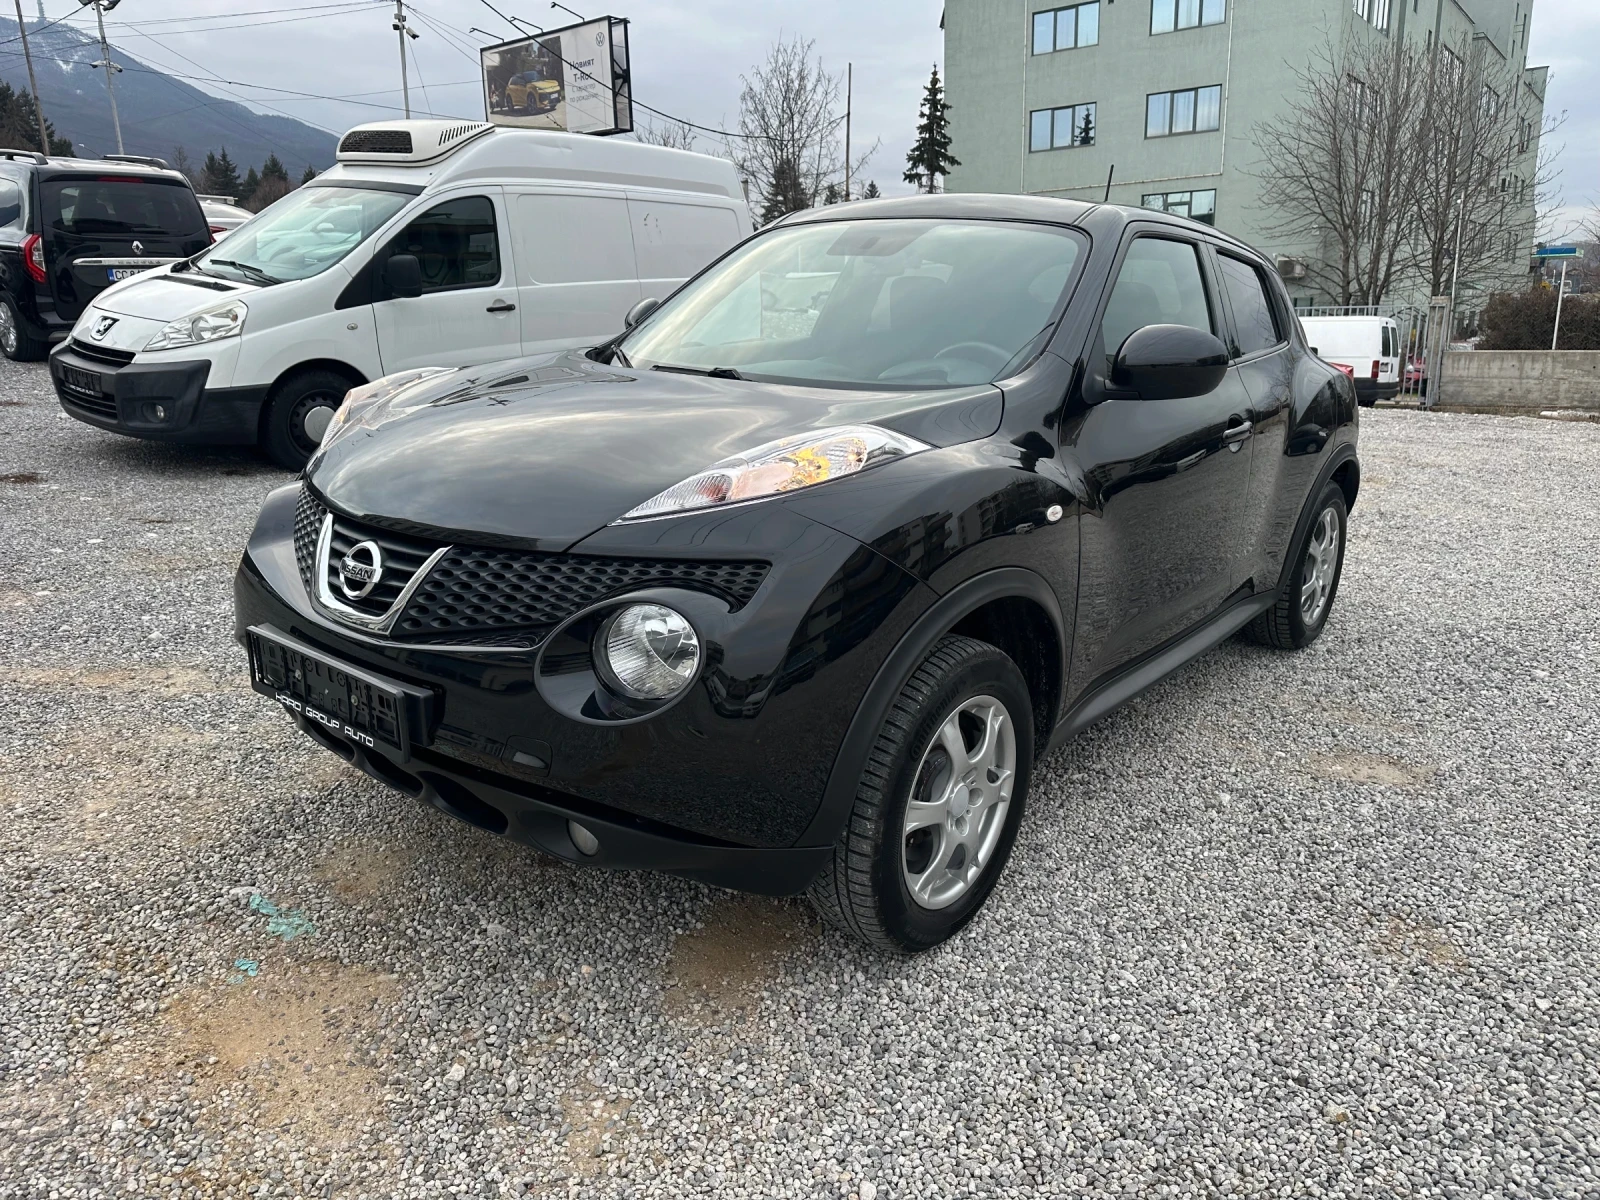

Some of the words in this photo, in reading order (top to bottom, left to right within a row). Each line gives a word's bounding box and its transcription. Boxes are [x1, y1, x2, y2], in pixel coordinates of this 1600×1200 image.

[570, 58, 594, 70] Новият
[342, 562, 374, 579] NISSAN
[306, 707, 339, 728] GROUP
[344, 726, 373, 747] AUTO
